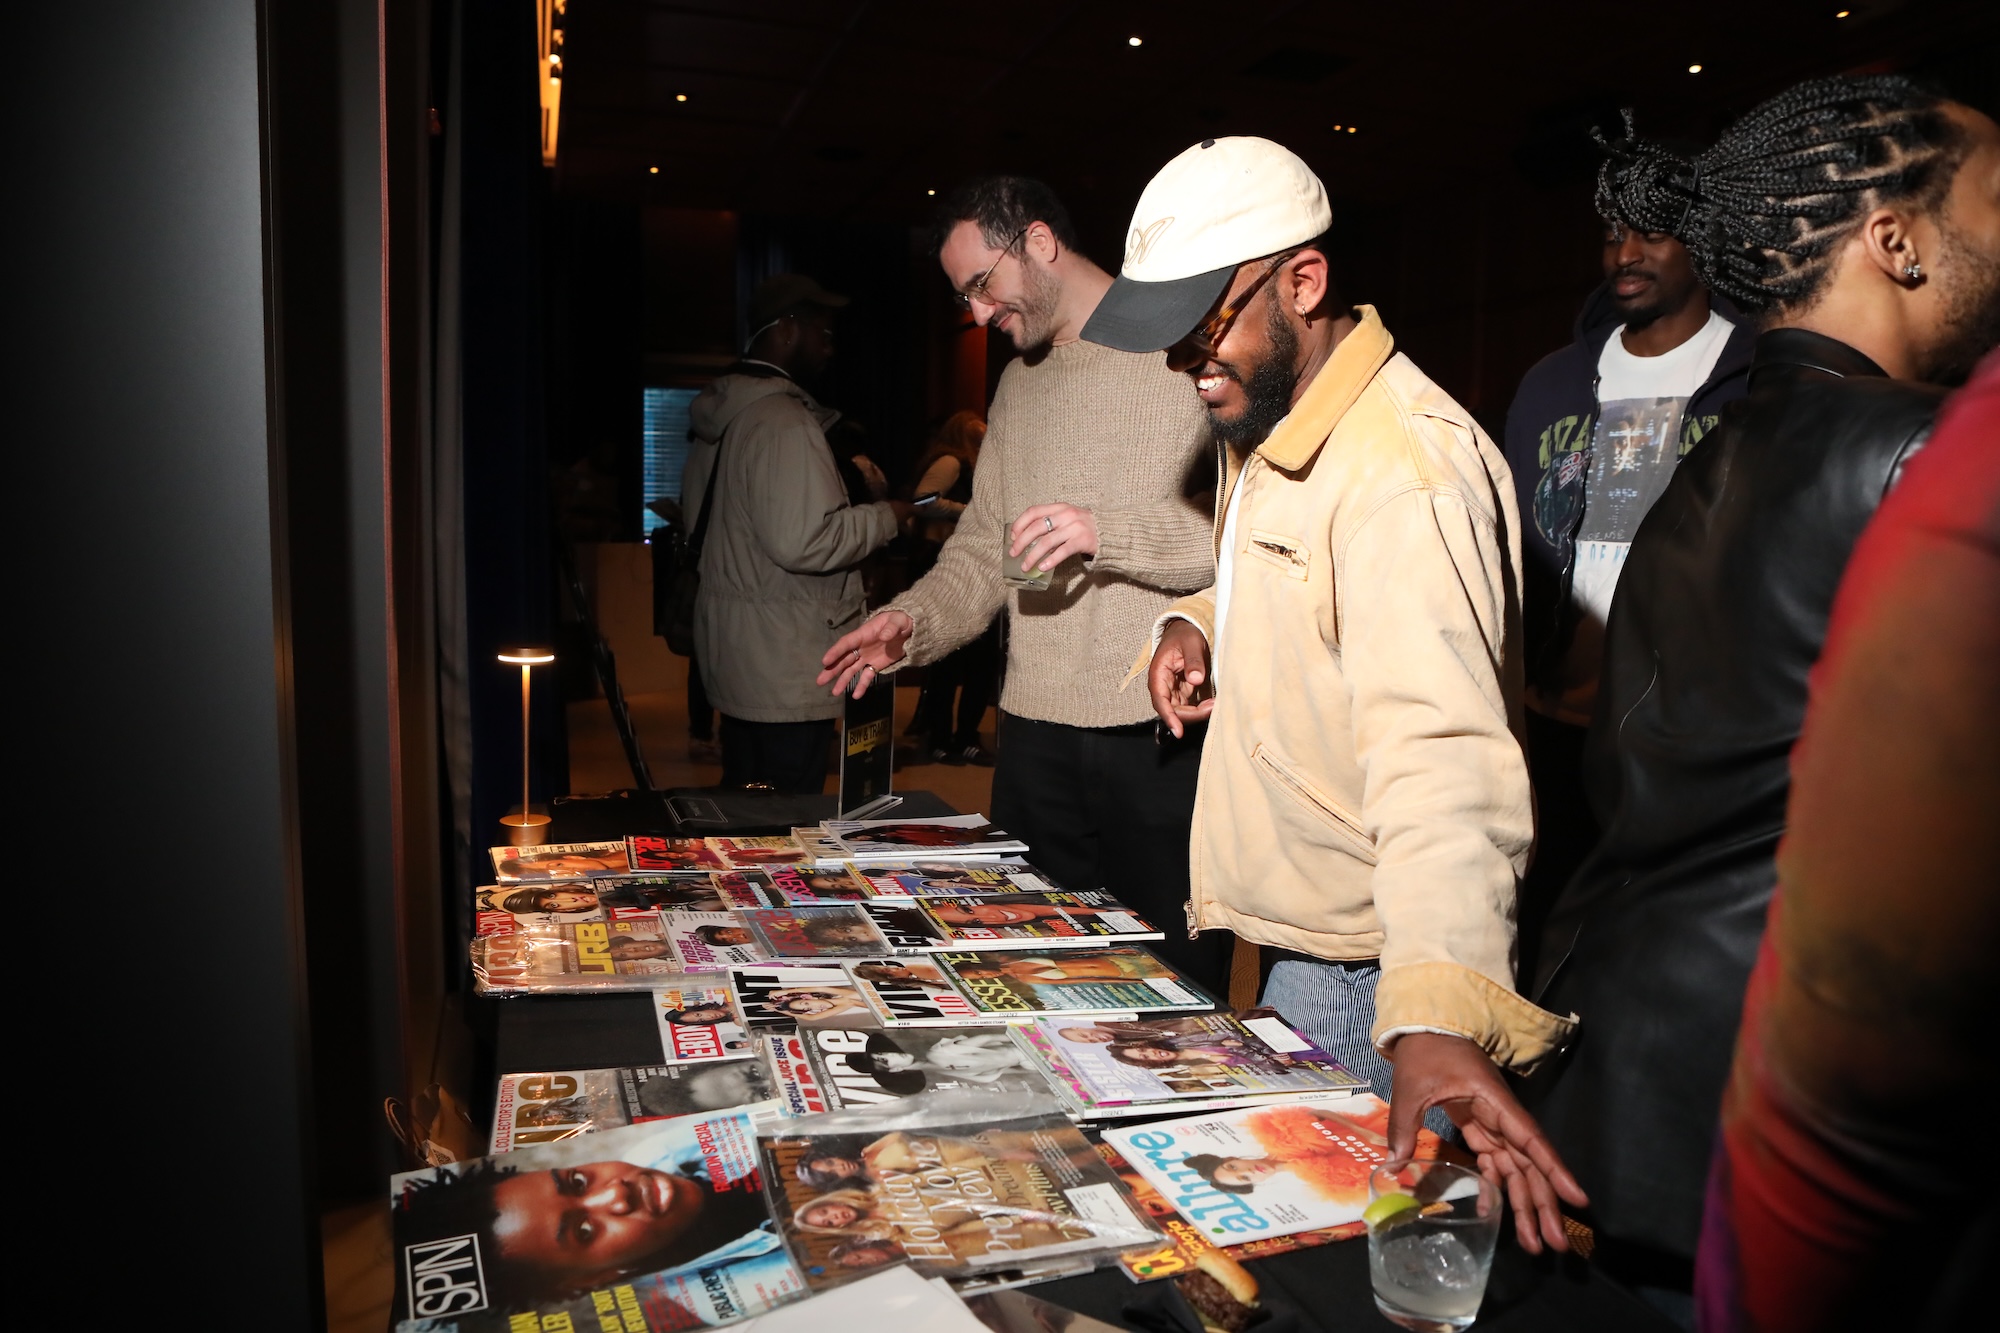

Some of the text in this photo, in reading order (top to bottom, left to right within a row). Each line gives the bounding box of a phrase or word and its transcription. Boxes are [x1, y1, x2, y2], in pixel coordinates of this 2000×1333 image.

[849, 728, 863, 746] BUY
[864, 726, 869, 741] &
[479, 912, 514, 933] SPIN
[615, 923, 631, 932] 19
[576, 923, 615, 974] URB
[677, 940, 700, 964] mass
[682, 931, 716, 962] appeal
[501, 1079, 515, 1102] EDITION
[771, 1037, 806, 1113] SPECIAL JUICE ISSUE
[495, 1103, 513, 1148] COLLECTOR'S
[1101, 1109, 1125, 1117] ESSENCE
[694, 1122, 731, 1192] FASHION SPECIAL
[1310, 1122, 1369, 1162] freedom
[1346, 1135, 1385, 1162] issue
[904, 1142, 974, 1213] Movie
[1022, 1163, 1062, 1198] Films
[1129, 1131, 1269, 1233] allure
[879, 1170, 956, 1261] Holiday
[412, 1238, 480, 1316] SPIN
